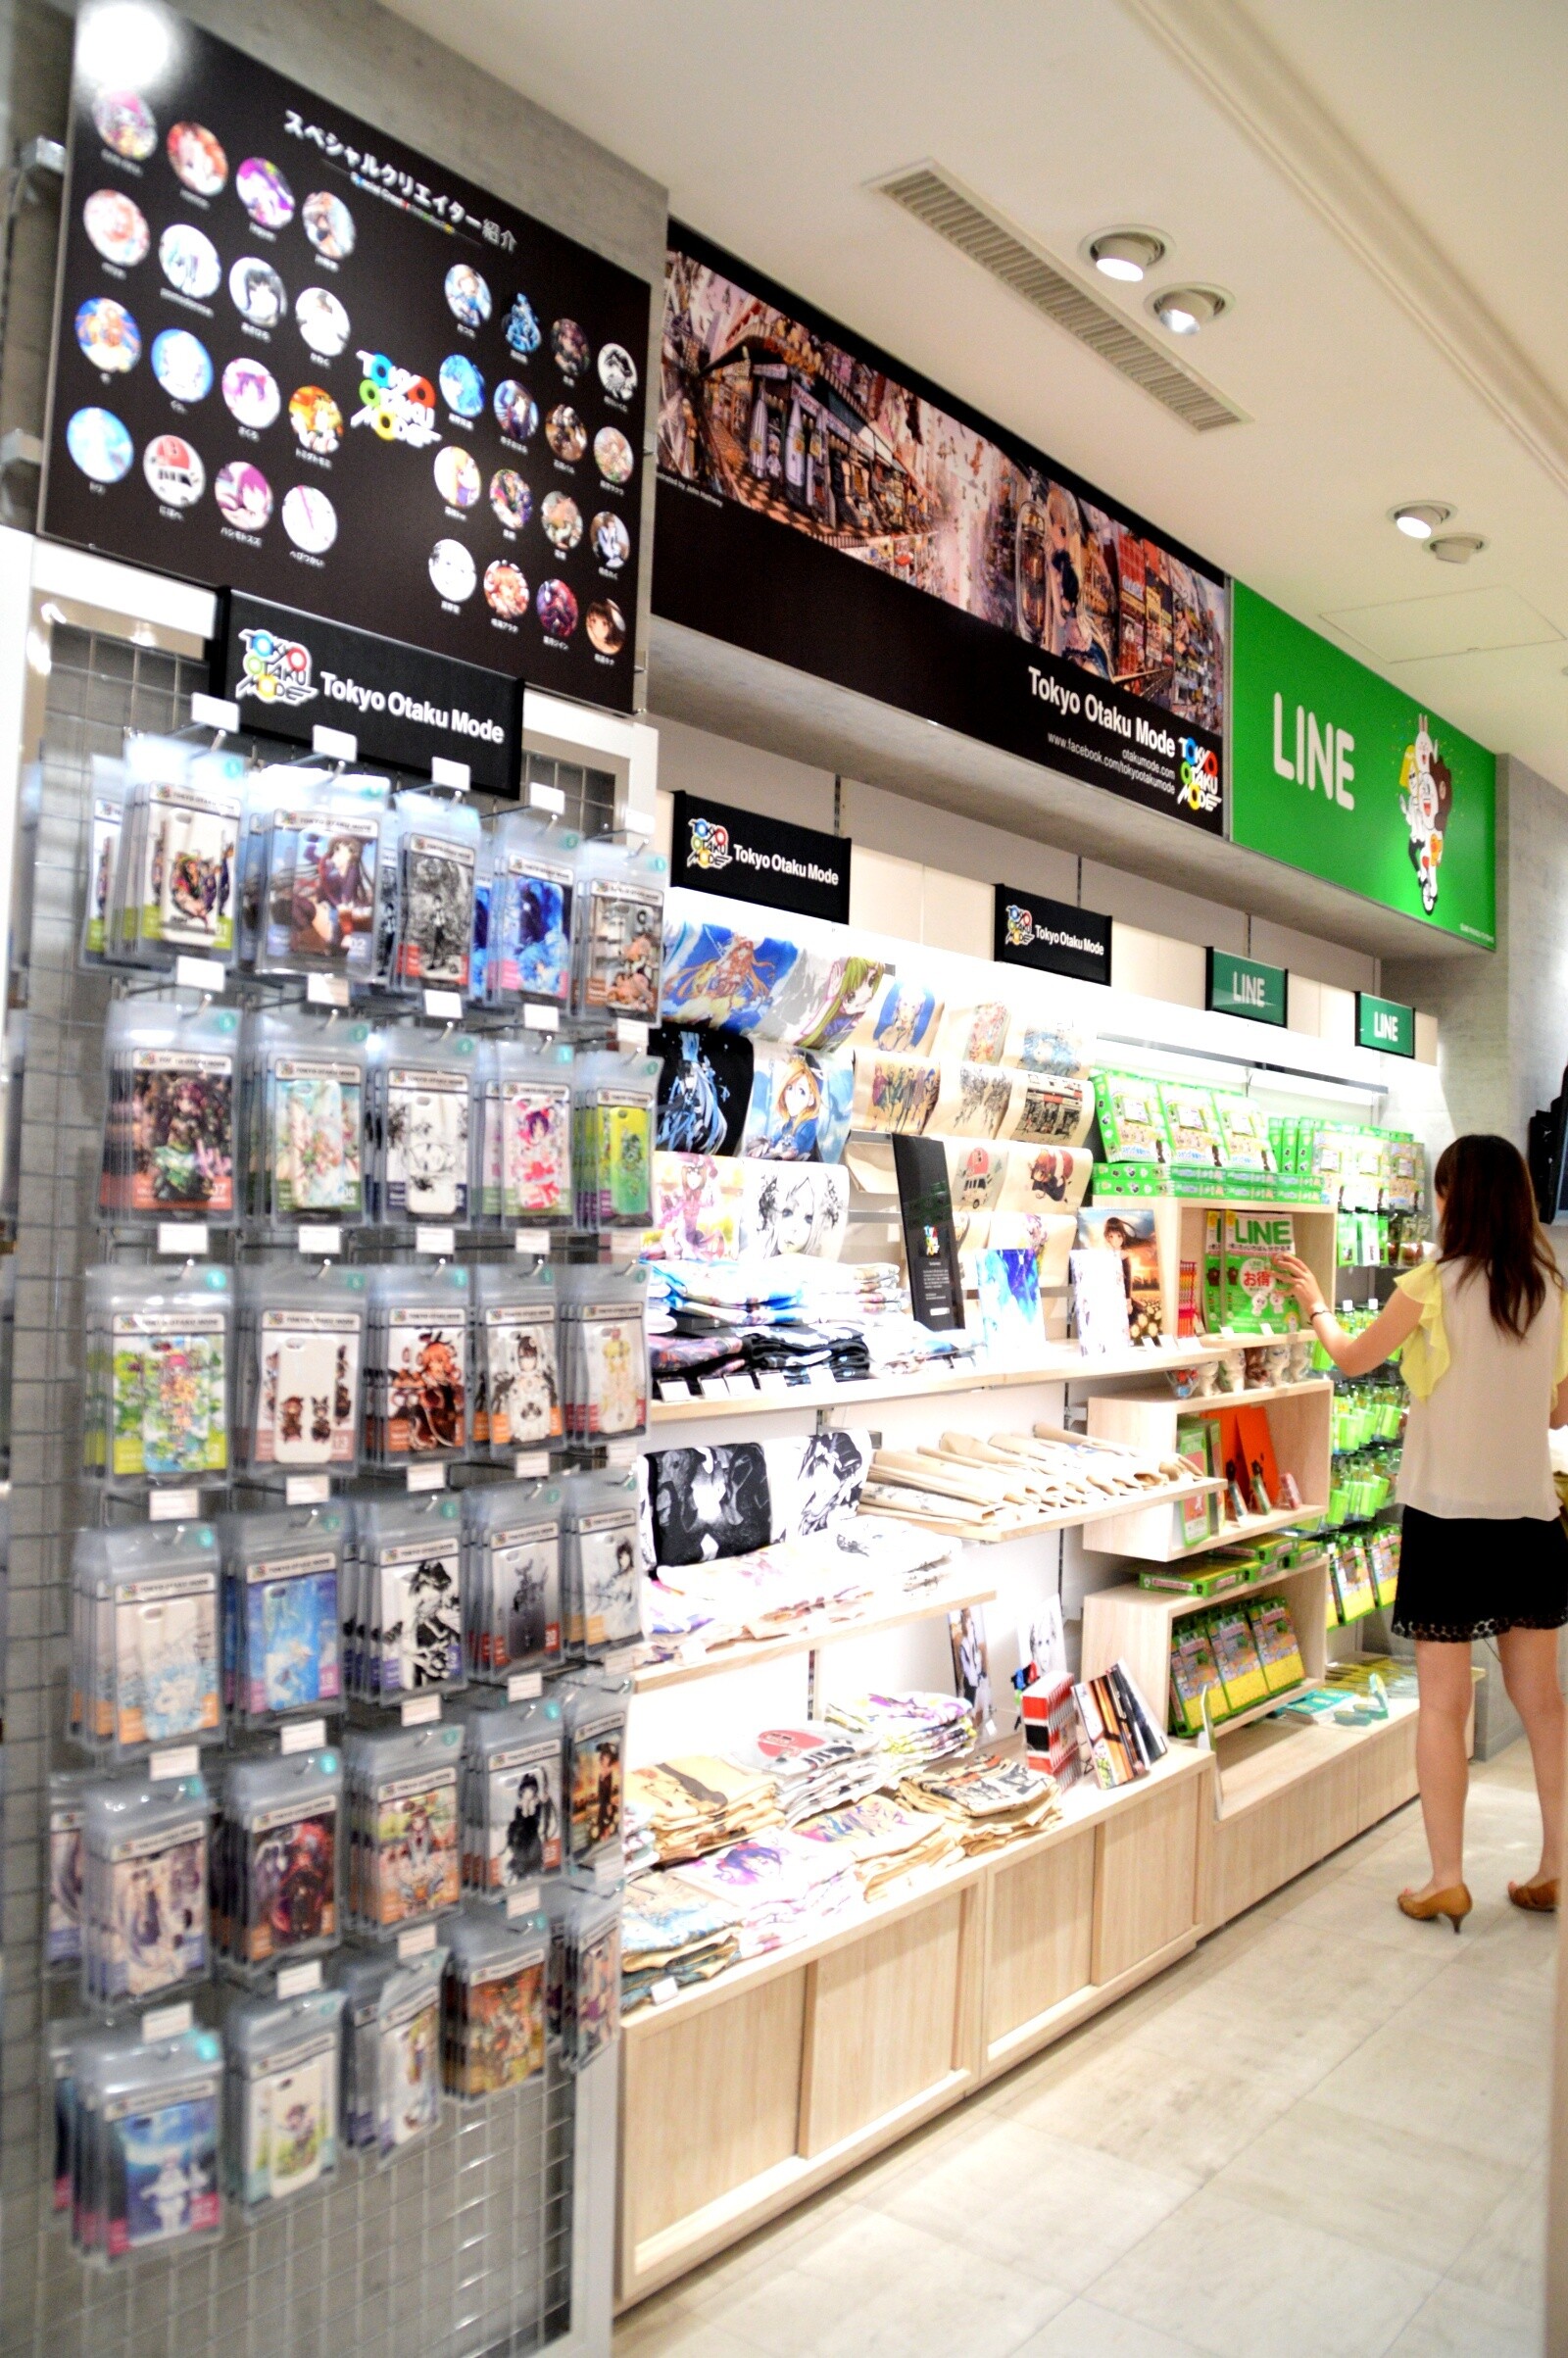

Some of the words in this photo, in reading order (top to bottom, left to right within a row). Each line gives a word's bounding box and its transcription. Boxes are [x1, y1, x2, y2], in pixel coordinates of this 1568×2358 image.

[284, 110, 517, 255] スペシャルクリエイター紹介
[239, 629, 311, 674] TOKYO
[236, 672, 318, 706] MODE
[244, 655, 311, 687] OTAKU
[320, 671, 385, 712] Tokyo
[388, 692, 449, 728] Otaku
[451, 709, 505, 744] Mode
[1028, 665, 1081, 715] Tokyo
[1085, 694, 1132, 739] Otaku
[1136, 716, 1176, 758] Mode
[1048, 732, 1176, 795] www.facebook.com/tokyootakumode
[1121, 749, 1176, 780] otakumode.com
[1178, 737, 1218, 777] TOKYO
[1274, 692, 1354, 811] LINE
[1181, 761, 1218, 795] OTAKU
[1177, 783, 1222, 812] MODE
[733, 844, 770, 870] Tokyo
[772, 854, 807, 878] Otaku
[808, 862, 839, 886] Mode
[1035, 924, 1059, 945] Tokyo
[1059, 932, 1083, 950] Otaku
[1084, 938, 1104, 956] Mode
[1233, 970, 1265, 1007] LINE
[1374, 1010, 1398, 1042] LINE
[1235, 1217, 1292, 1246] LINE
